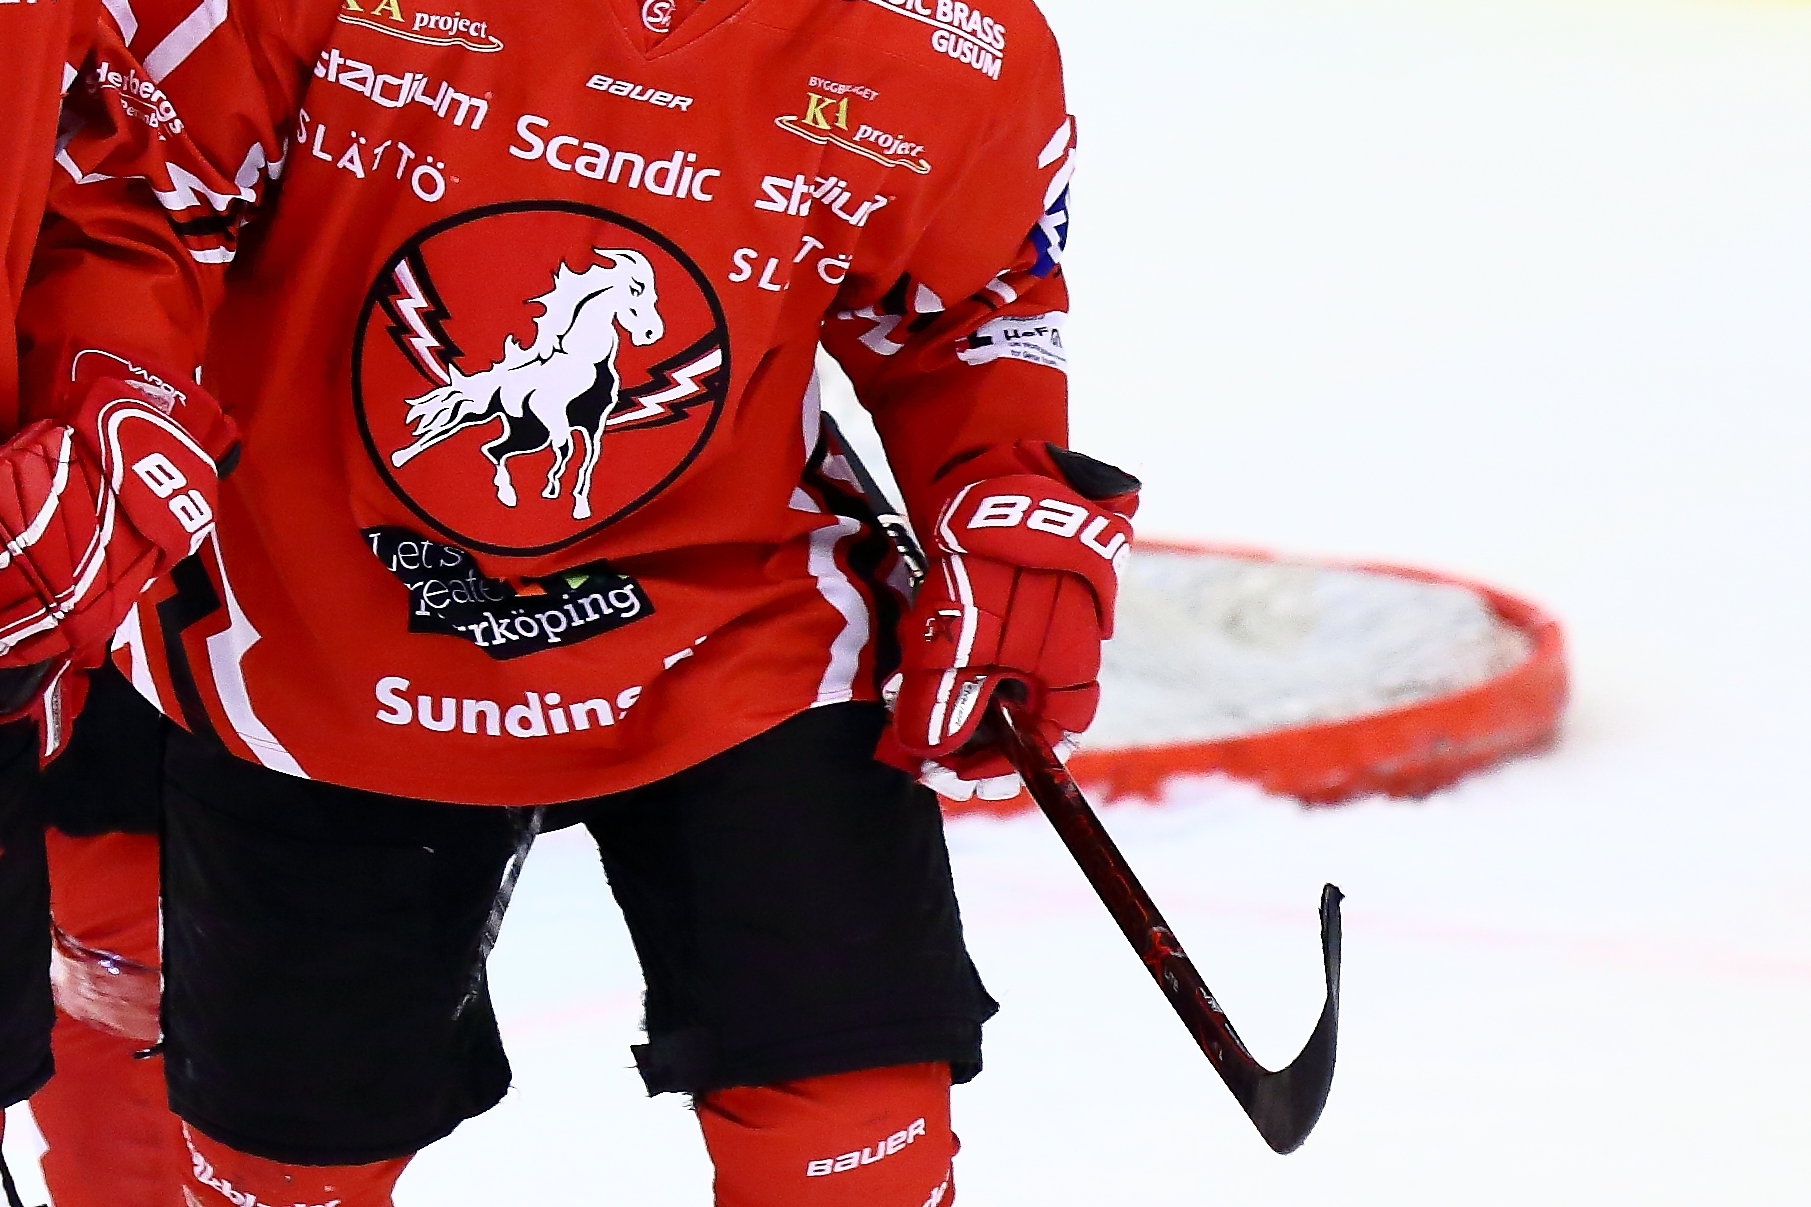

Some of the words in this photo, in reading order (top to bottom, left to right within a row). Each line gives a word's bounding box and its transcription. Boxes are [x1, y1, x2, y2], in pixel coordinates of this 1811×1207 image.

[411, 11, 489, 40] project
[934, 0, 1006, 51] BRASS
[930, 29, 1002, 82] GUSUM
[586, 73, 693, 112] BAUER
[508, 112, 721, 204] Scandic
[806, 1117, 927, 1178] BAUER
